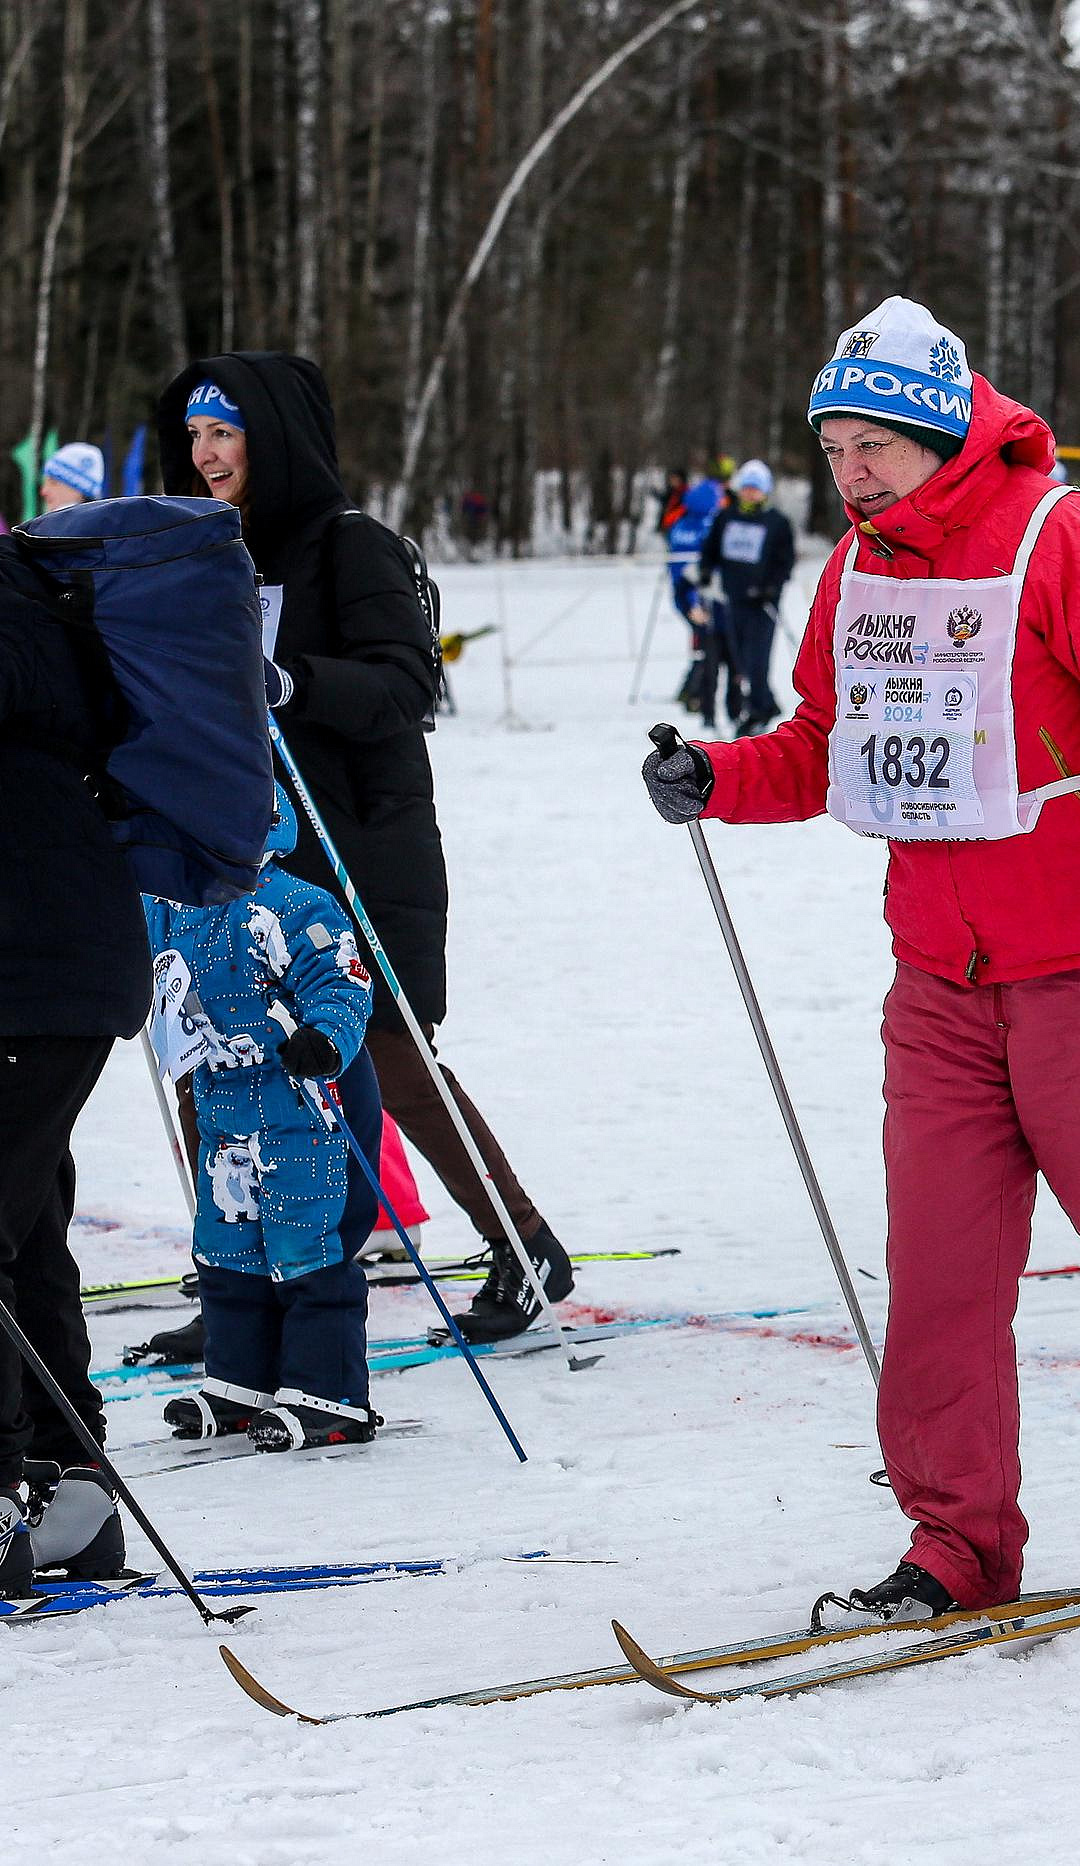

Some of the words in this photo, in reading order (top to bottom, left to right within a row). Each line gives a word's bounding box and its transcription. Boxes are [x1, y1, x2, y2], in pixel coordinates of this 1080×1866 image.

[847, 613, 917, 639] ЛЫЖНЯ
[844, 636, 914, 664] РОССИИ
[884, 677, 923, 690] ЛЫЖНЯ
[884, 690, 923, 704] РОССИИ
[883, 705, 923, 722] 2024
[860, 734, 950, 788] 1832
[900, 801, 957, 811] НОВОСИБИРСКАЯ
[901, 811, 932, 821] ОБЛАСТЬ
[515, 1256, 540, 1306] NORDY
